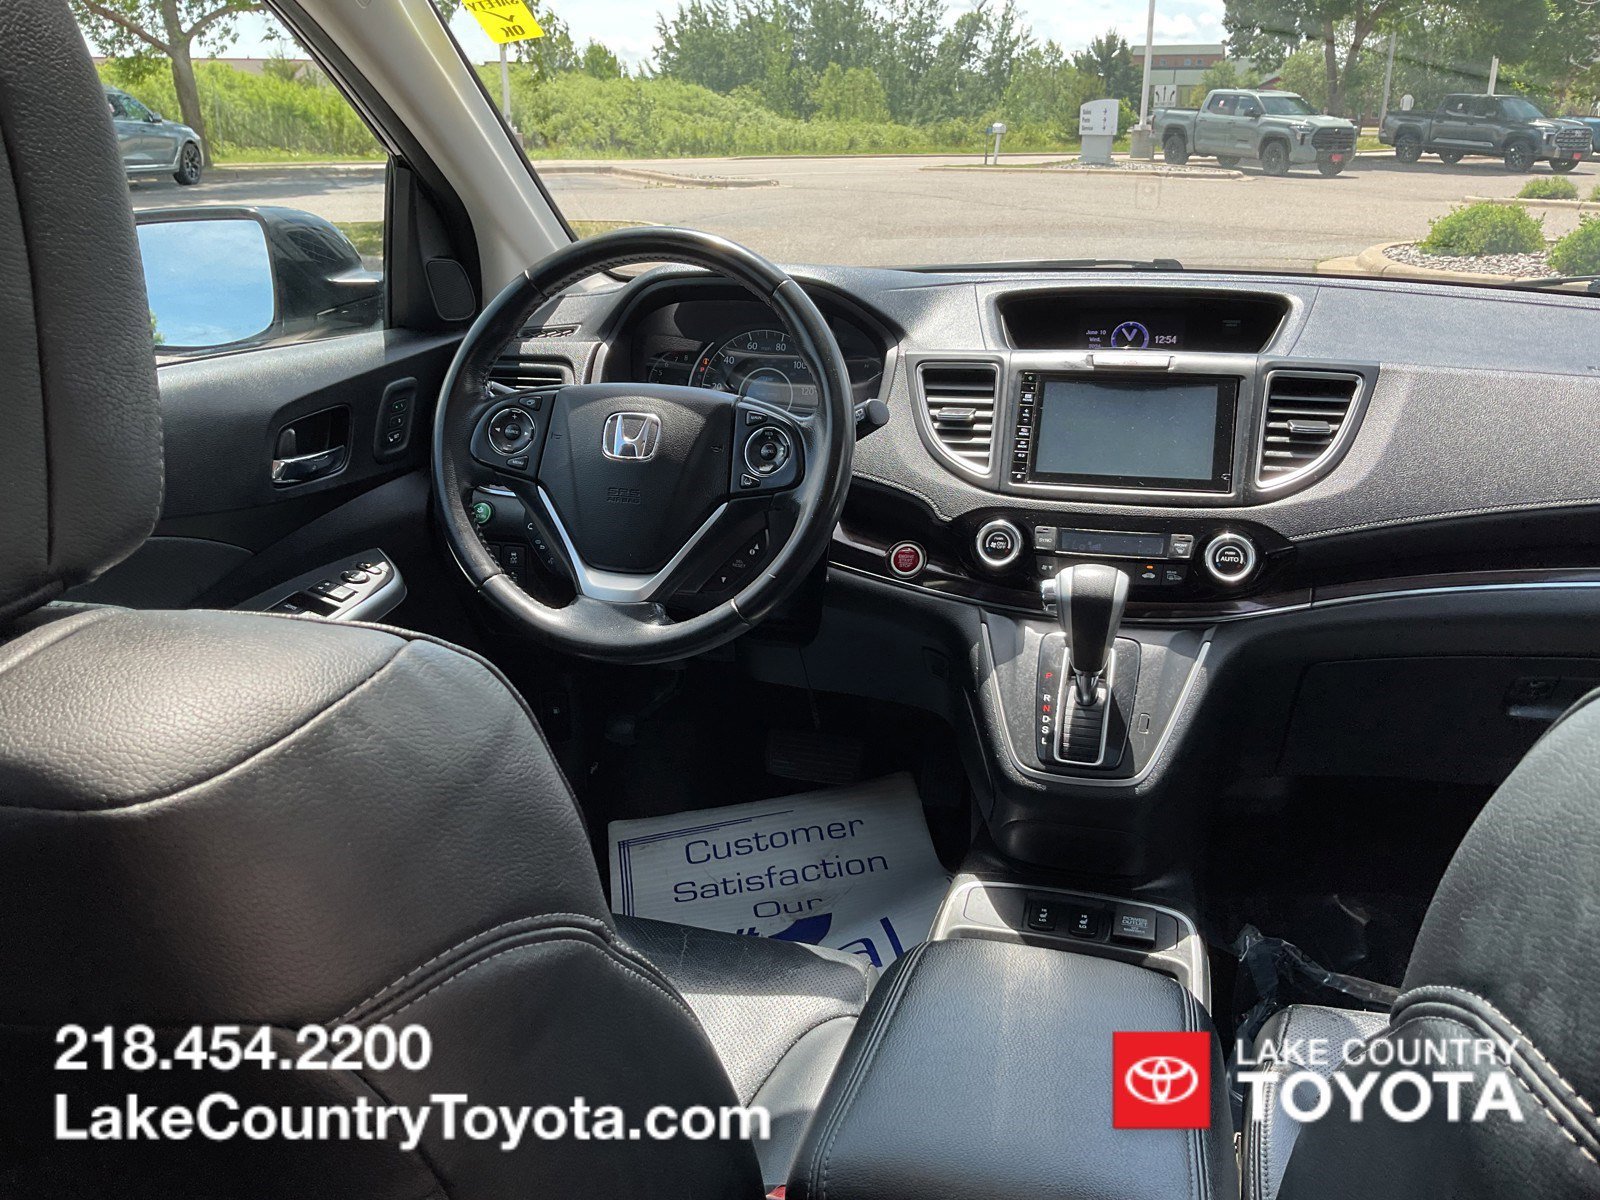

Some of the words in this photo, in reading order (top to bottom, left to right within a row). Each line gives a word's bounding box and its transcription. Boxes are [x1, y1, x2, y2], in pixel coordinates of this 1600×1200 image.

[501, 24, 526, 38] OK
[1155, 336, 1177, 344] 12:54
[747, 342, 758, 350] 60
[775, 343, 786, 351] 80
[724, 356, 735, 364] 40
[801, 387, 815, 395] 120
[1041, 726, 1049, 734] S
[1041, 737, 1047, 745] L
[685, 819, 864, 865] Customer
[673, 854, 889, 903] Satisfaction
[753, 898, 823, 918] Our
